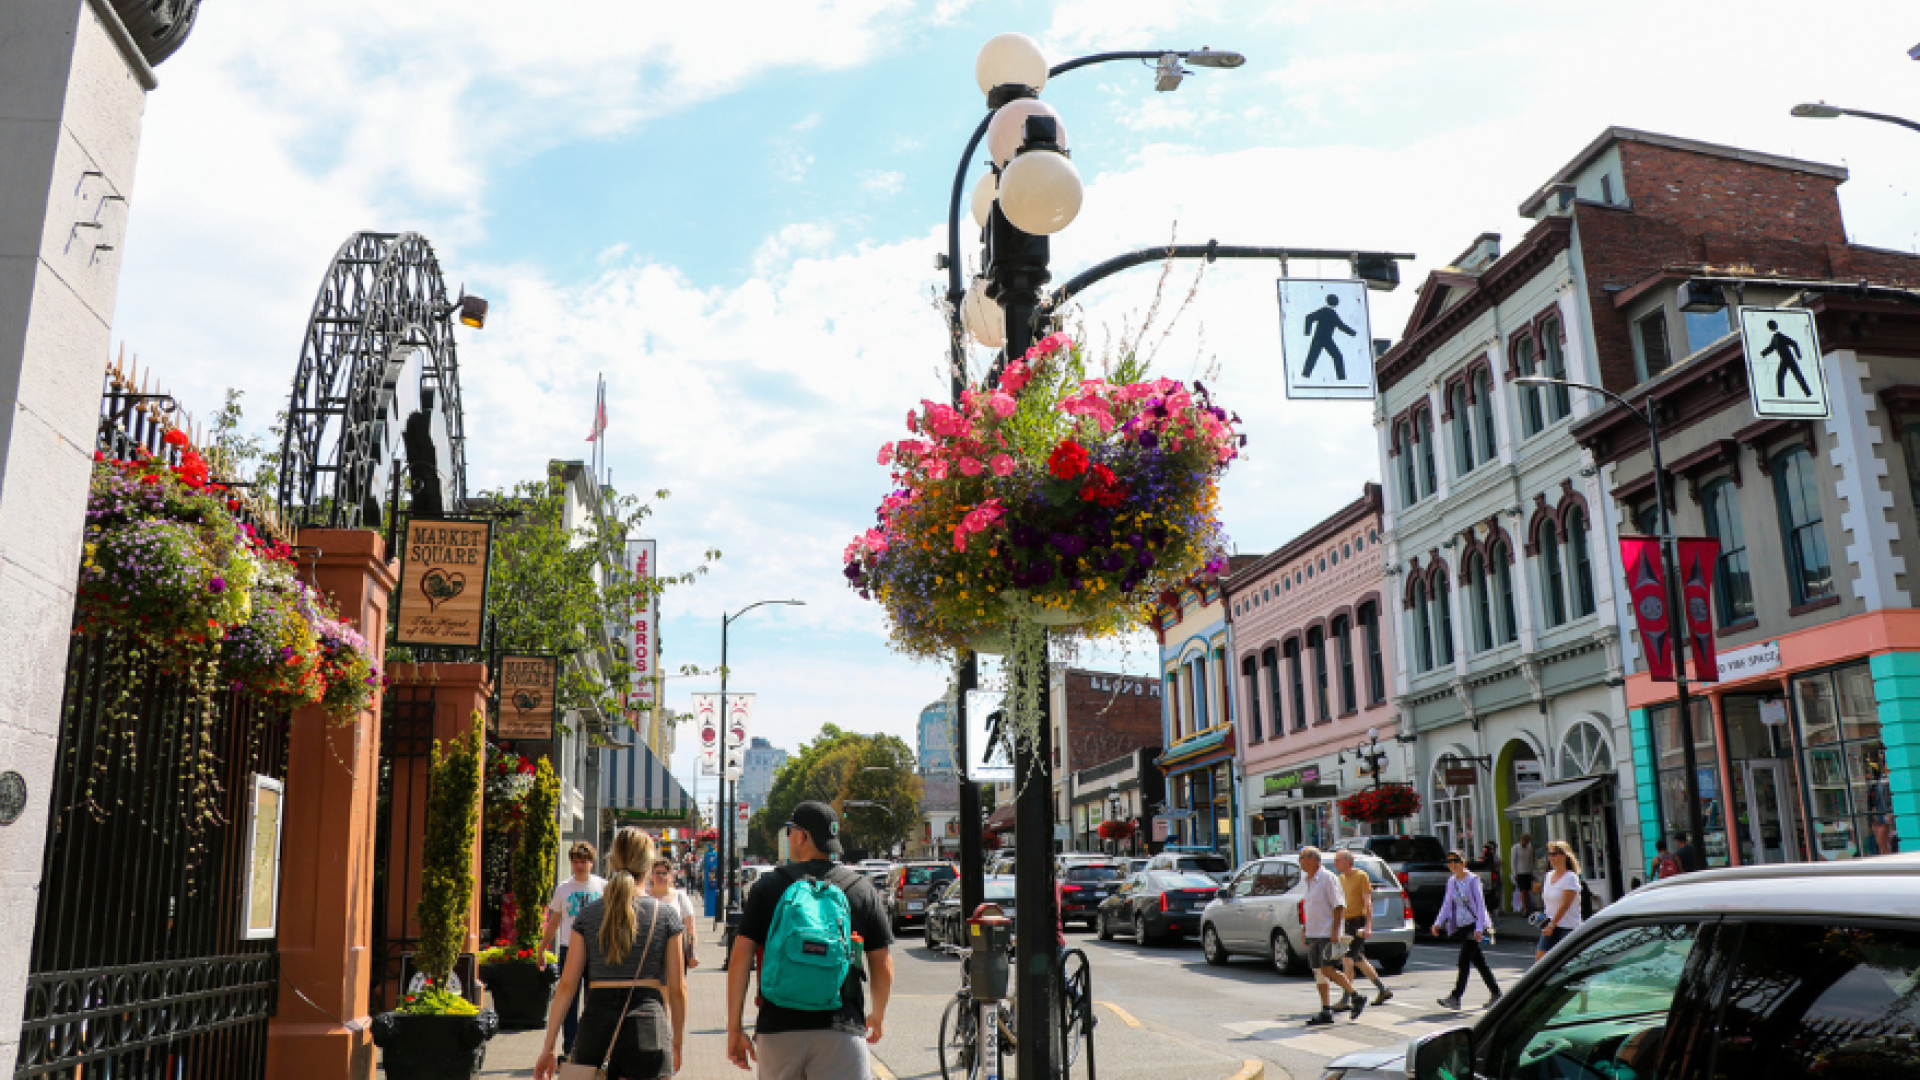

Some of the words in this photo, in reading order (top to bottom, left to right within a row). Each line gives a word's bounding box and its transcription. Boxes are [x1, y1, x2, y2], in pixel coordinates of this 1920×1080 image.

[413, 528, 481, 546] MARKET
[411, 546, 477, 566] SQUARE
[635, 619, 648, 673] BROS
[505, 662, 550, 674] MARKET
[504, 672, 549, 687] SQUARE
[1090, 676, 1142, 696] LLOYD
